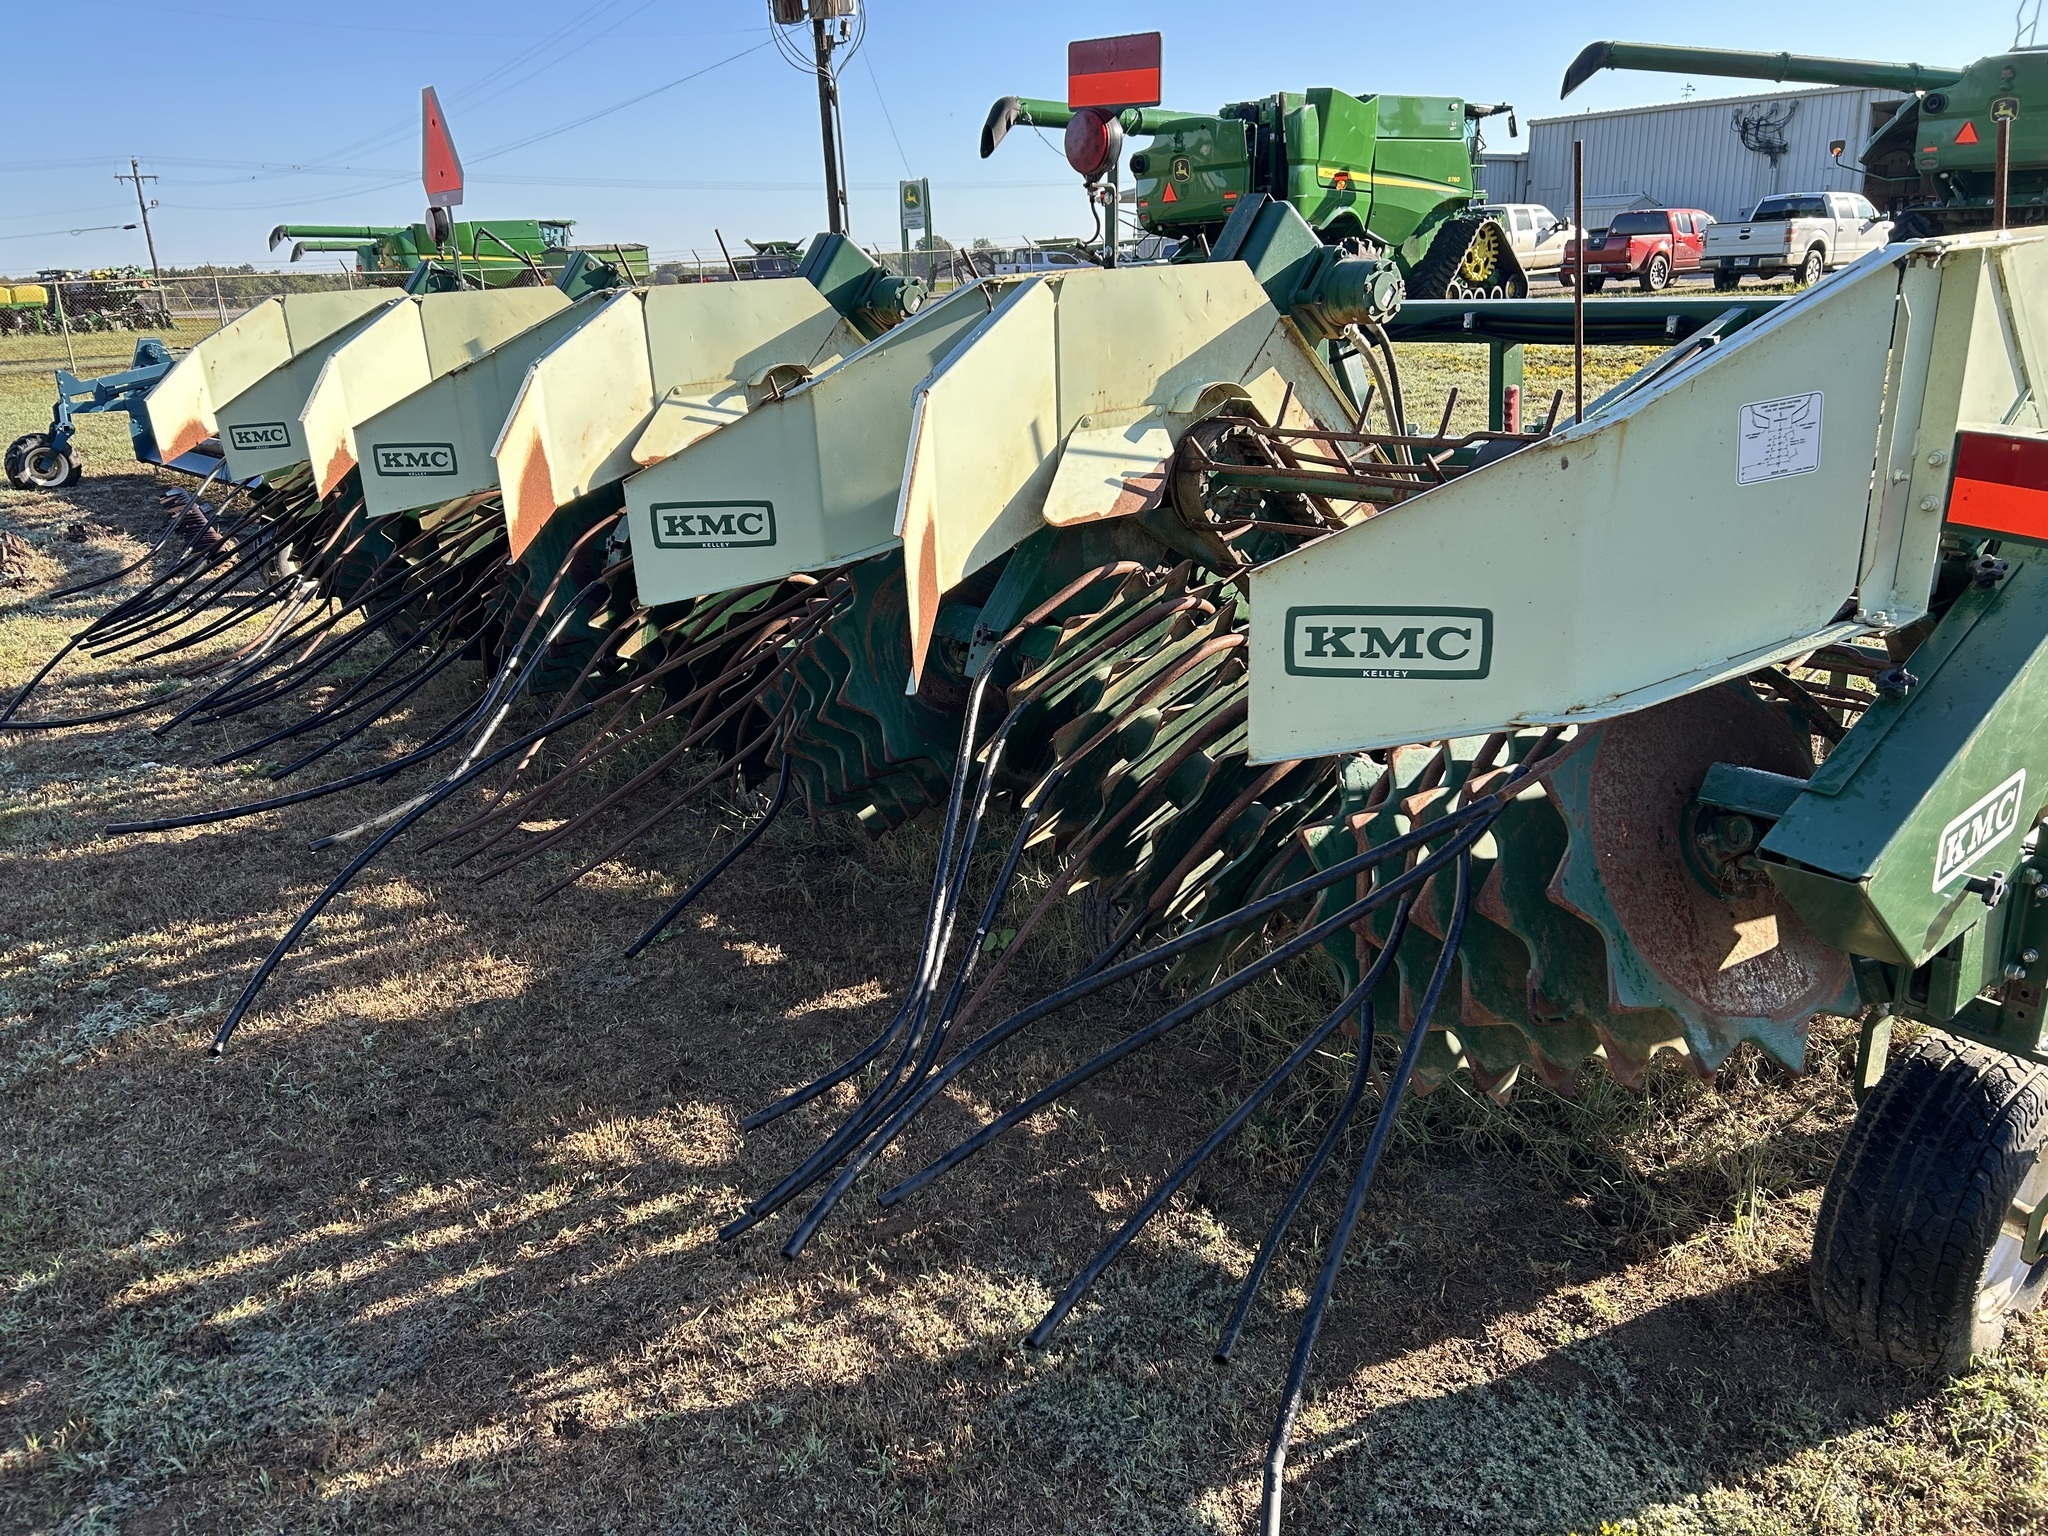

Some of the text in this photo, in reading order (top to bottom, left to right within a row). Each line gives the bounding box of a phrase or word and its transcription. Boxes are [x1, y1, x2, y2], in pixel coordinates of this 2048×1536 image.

[236, 429, 284, 443] KMC
[381, 451, 449, 467] KMC
[663, 513, 763, 536] KMC
[1305, 626, 1472, 661] KMC
[1363, 669, 1409, 678] KELLEY
[1941, 787, 2017, 874] KMC
